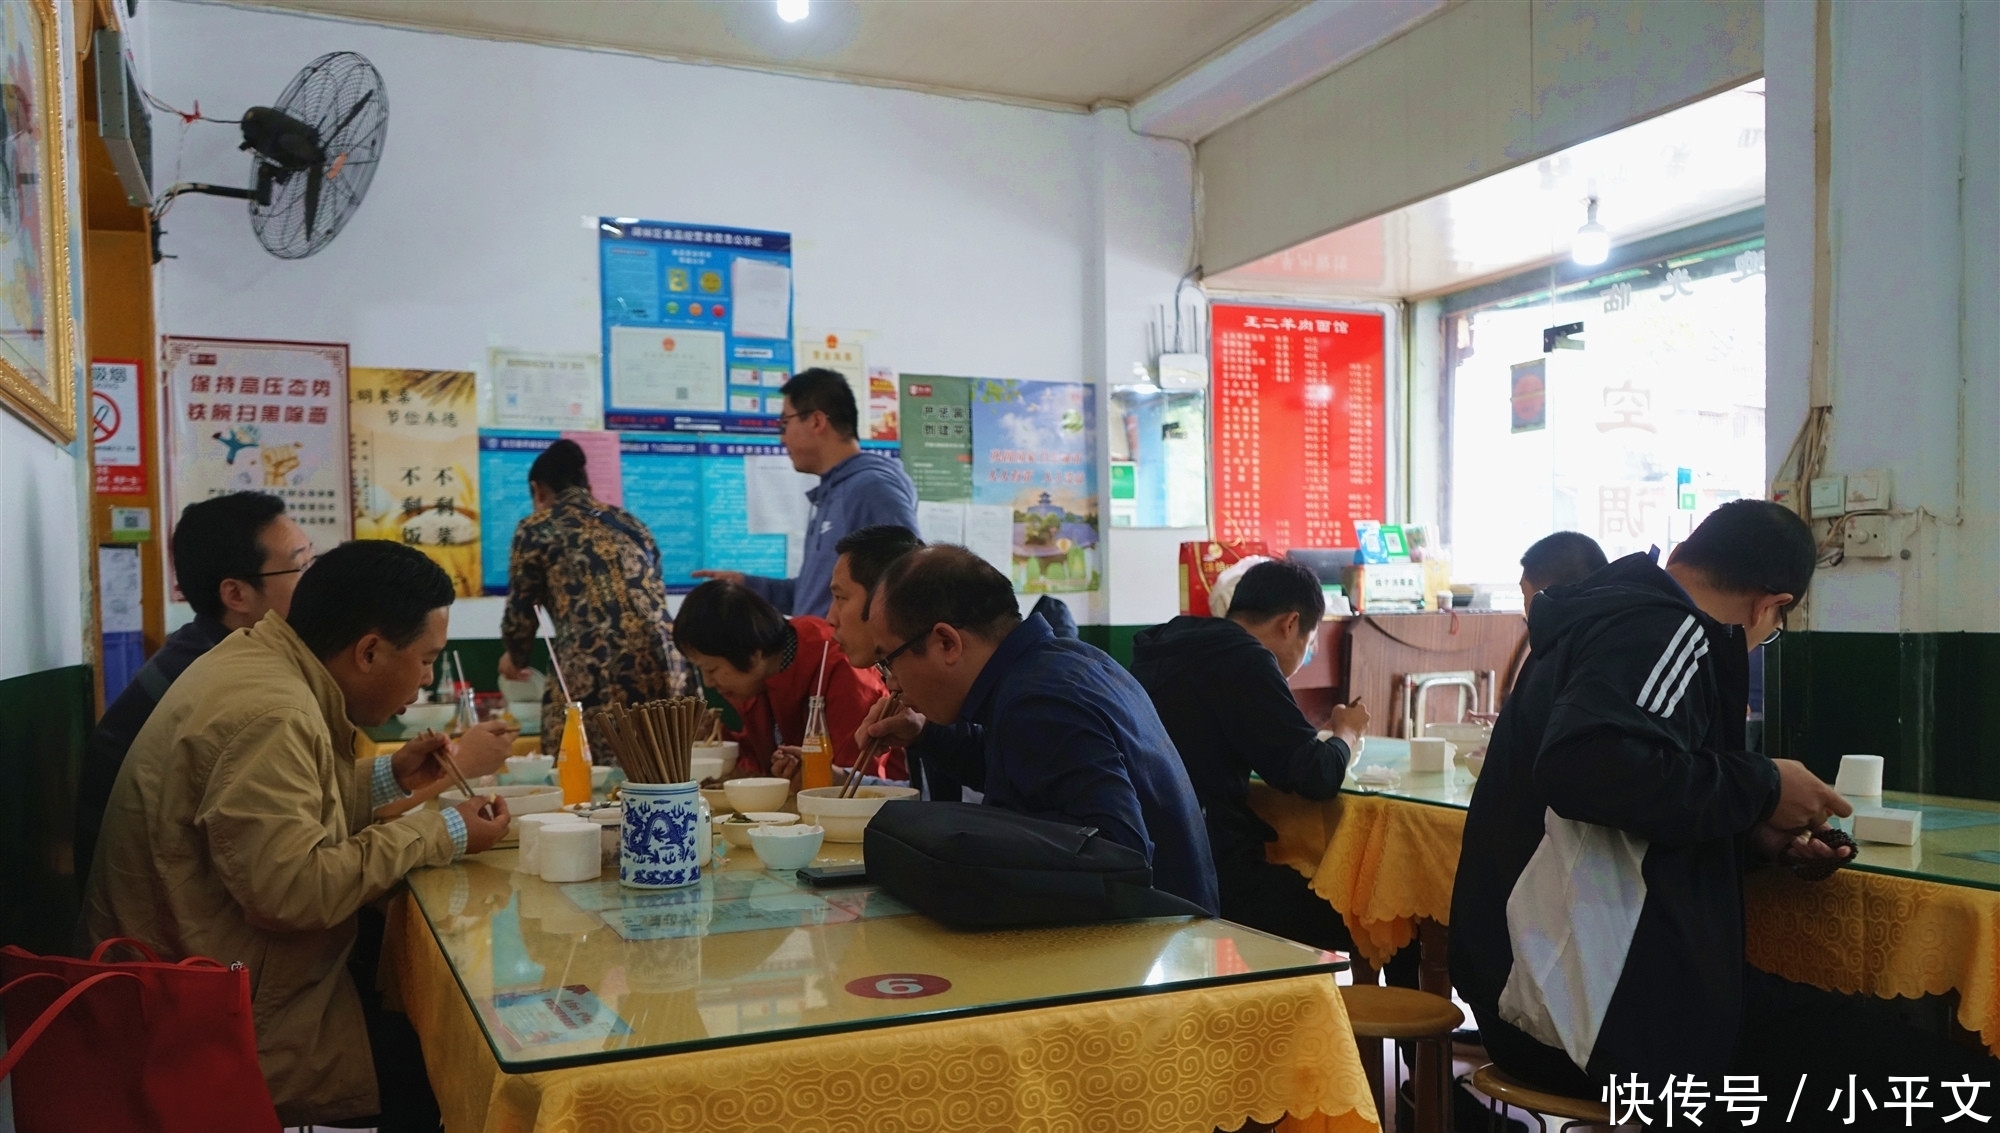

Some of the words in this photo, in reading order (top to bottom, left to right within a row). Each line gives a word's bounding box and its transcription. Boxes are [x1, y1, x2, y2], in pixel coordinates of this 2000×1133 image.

[1243, 315, 1349, 334] 王二羊肉面馆
[92, 366, 127, 384] 吸烟
[190, 374, 331, 398] 保持高压态势
[352, 388, 411, 403] 明餐桌
[187, 402, 329, 425] 铁腕扫黑除恶
[388, 409, 459, 428] 节俭养德
[922, 422, 967, 438] 创建平
[401, 466, 423, 546] 不剩饭
[434, 466, 456, 547] 不剩菜
[875, 977, 924, 994] 6
